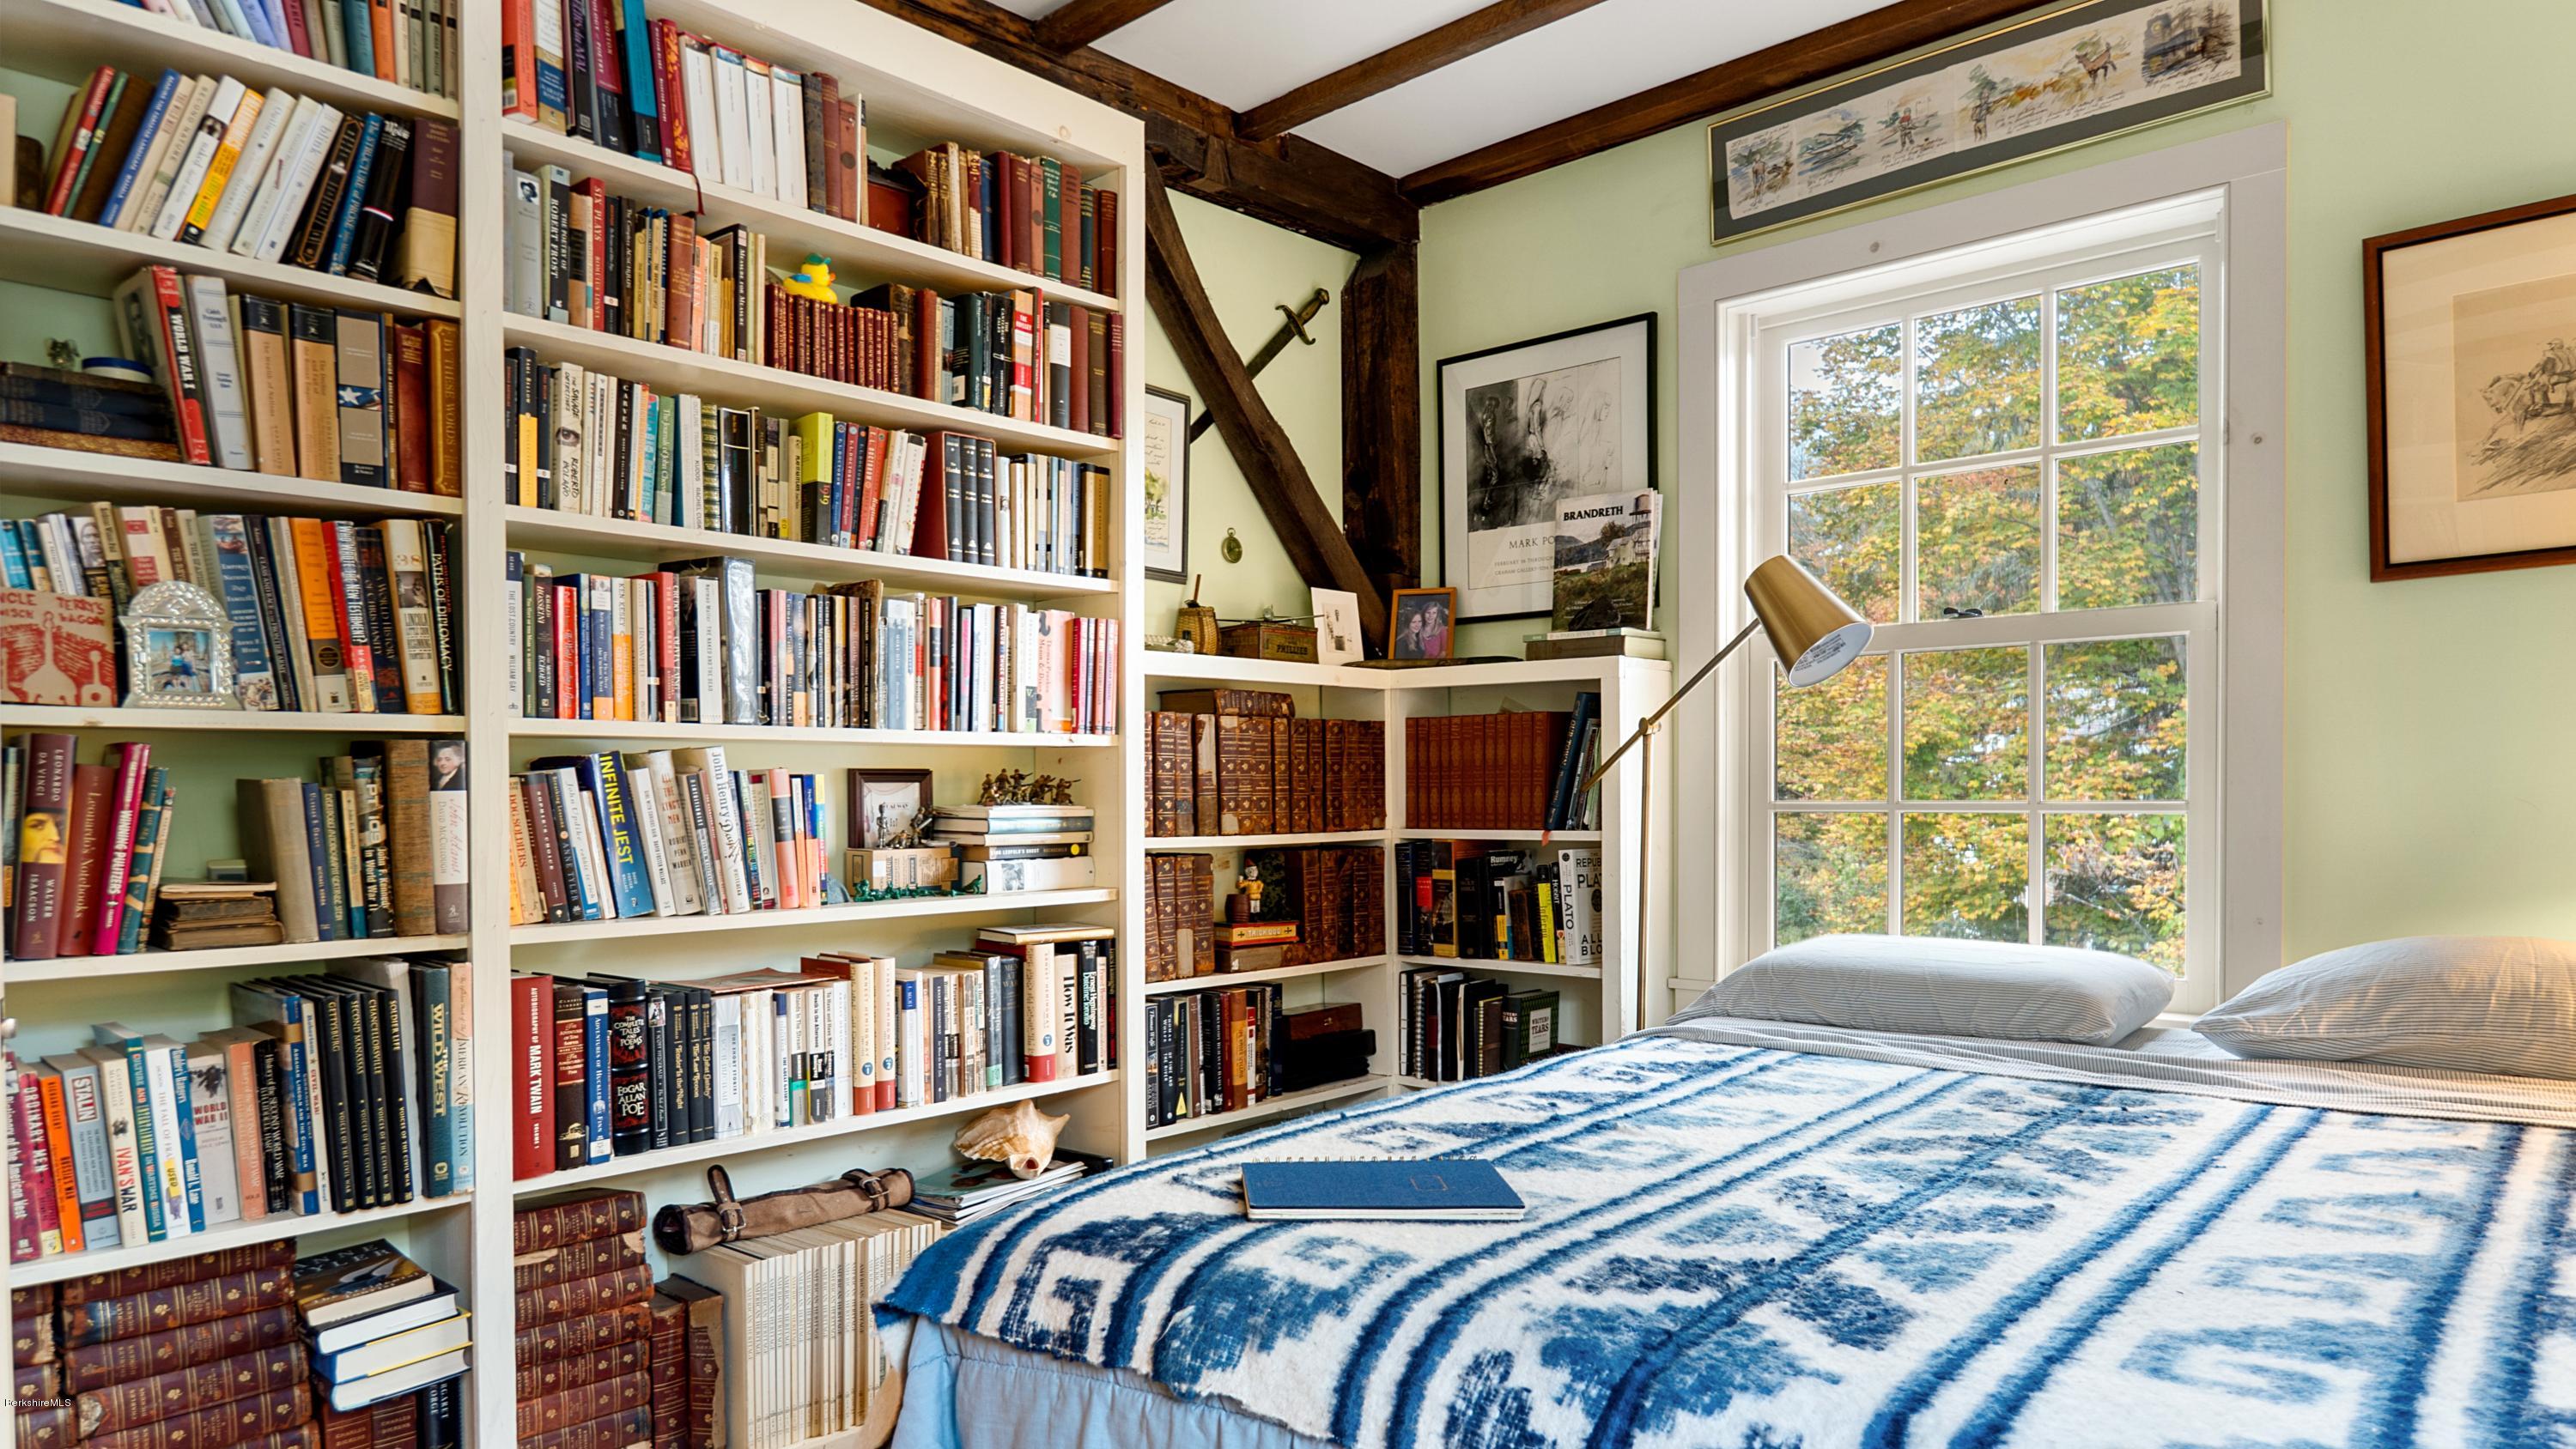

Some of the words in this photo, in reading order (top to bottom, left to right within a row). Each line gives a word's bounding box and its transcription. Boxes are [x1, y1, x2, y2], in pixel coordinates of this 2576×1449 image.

[310, 125, 332, 154] blink
[355, 136, 376, 188] STRUCTURE
[594, 185, 603, 206] SIX
[344, 200, 359, 228] PROSE
[550, 198, 560, 240] ROBERT
[594, 209, 603, 242] PLAYS
[550, 243, 560, 278] FROST
[561, 259, 568, 270] OF
[171, 314, 190, 353] WORLD
[445, 338, 454, 354] BY
[179, 355, 192, 378] WAR
[445, 357, 457, 398] THESE
[183, 380, 195, 390] I
[446, 403, 457, 446] WORDS
[571, 457, 580, 499] ROBERTO
[820, 484, 830, 506] 1919
[1562, 505, 1624, 521] BRANDRETH
[339, 525, 354, 543] WHO
[1509, 537, 1539, 549] MARK
[1542, 535, 1555, 545] PO
[341, 543, 355, 567] WROTE
[433, 553, 444, 585] PATHS
[346, 584, 361, 600] NEW
[435, 588, 446, 603] OF
[538, 585, 546, 624] HOSSEINI
[349, 601, 368, 643] TESTAMENT?
[437, 605, 453, 671] DIPLOMACY
[1276, 645, 1309, 656] PHILLIES
[538, 654, 547, 687] ECHOED
[39, 752, 46, 766] DA
[35, 768, 46, 797] VINCI
[51, 749, 64, 802] LEONARDO
[509, 794, 519, 815] DOG
[599, 755, 625, 825] INFINITE
[613, 829, 634, 864] JEST
[81, 792, 102, 855] Leonardo's
[115, 809, 133, 850] WINNING
[513, 817, 528, 869] SOLDIERS
[562, 842, 573, 869] ANNE
[106, 852, 126, 895] PULITZERS
[1490, 855, 1518, 864] Rumney
[1576, 858, 1601, 868] REPUB
[27, 873, 39, 923] ISAACSON
[45, 879, 55, 919] WALTER
[74, 858, 94, 919] Notebooks
[566, 872, 578, 901] TYLER
[1564, 884, 1574, 930] PLATO
[1581, 934, 1601, 944] ALL
[1063, 974, 1075, 1009] How
[1083, 972, 1091, 1001] Dateline:
[351, 1000, 361, 1033] SECOND
[390, 999, 399, 1034] SOLDIER
[531, 987, 539, 1034] AUTOBIOGRAPHY
[613, 1019, 645, 1029] COMPLETE
[1064, 1011, 1076, 1024] It
[1083, 1001, 1091, 1026] Toronto
[1088, 993, 1098, 1030] Hemingway
[328, 1001, 340, 1052] GETTYSBURG
[433, 1003, 446, 1058] WILD
[594, 1016, 603, 1058] ADVENTURES
[620, 1026, 641, 1035] TALES
[1064, 1024, 1077, 1054] Was
[1531, 1023, 1549, 1035] TEARS
[353, 1034, 365, 1075] MANASSAS
[392, 1034, 401, 1052] LIFE
[620, 1036, 643, 1047] POEMS
[369, 998, 382, 1076] CHANCELLORSVILLE
[380, 1131, 386, 1140] OF
[456, 1037, 470, 1086] AMERICAN
[529, 1044, 542, 1077] MARK
[73, 1076, 96, 1122] STALIN
[433, 1058, 447, 1119] WEST
[530, 1077, 543, 1114] TWAIN
[617, 1082, 647, 1096] EDGAR
[618, 1091, 646, 1105] ALLAN
[194, 1101, 227, 1115] WORLD
[194, 1113, 216, 1125] WAR
[220, 1111, 228, 1121] II
[338, 1111, 347, 1134] VOICES
[622, 1101, 645, 1116] POE
[26, 1086, 44, 1142] ORDINARY
[35, 1148, 50, 1173] MEN
[362, 1132, 368, 1142] OF
[400, 1130, 407, 1140] OF
[454, 1091, 470, 1156] REVOLUTION
[340, 1135, 347, 1144] OF
[115, 1146, 135, 1187] IVAN'S
[167, 1167, 179, 1188] USED
[121, 1186, 138, 1213] WAR
